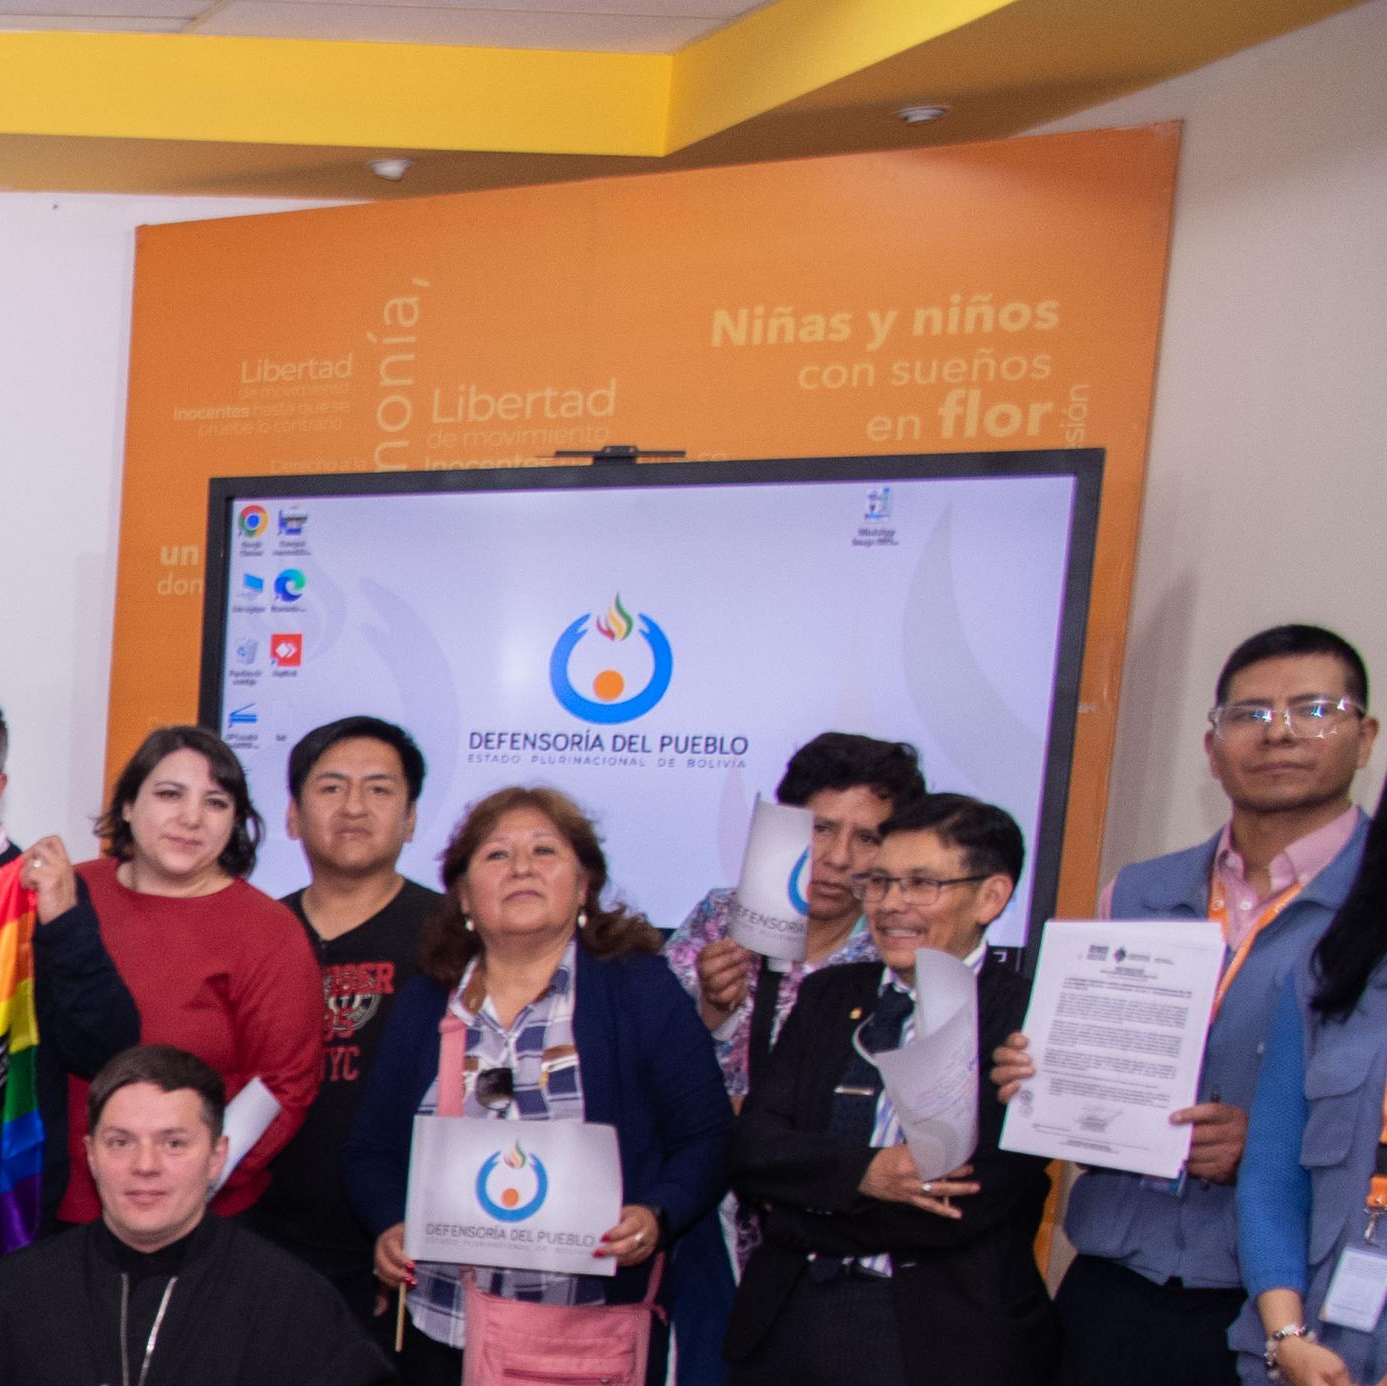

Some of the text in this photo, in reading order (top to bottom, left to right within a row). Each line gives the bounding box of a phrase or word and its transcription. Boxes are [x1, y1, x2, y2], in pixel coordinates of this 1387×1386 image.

[710, 294, 1061, 352] Niñas y niños
[241, 352, 354, 384] Libertad
[798, 348, 1052, 390] con sueños
[432, 377, 617, 424] Libertad
[866, 389, 1053, 443] en flor
[428, 424, 610, 449] de movimiento
[468, 730, 748, 755] DEFENSORÍA DEL PUEBLO
[467, 754, 747, 769] ESTADO PLURINACIONAL DE BOLIVIA
[426, 1223, 507, 1241] DEFENSORÍA
[510, 1229, 534, 1242] DEL
[537, 1231, 596, 1248] PUEBLO
